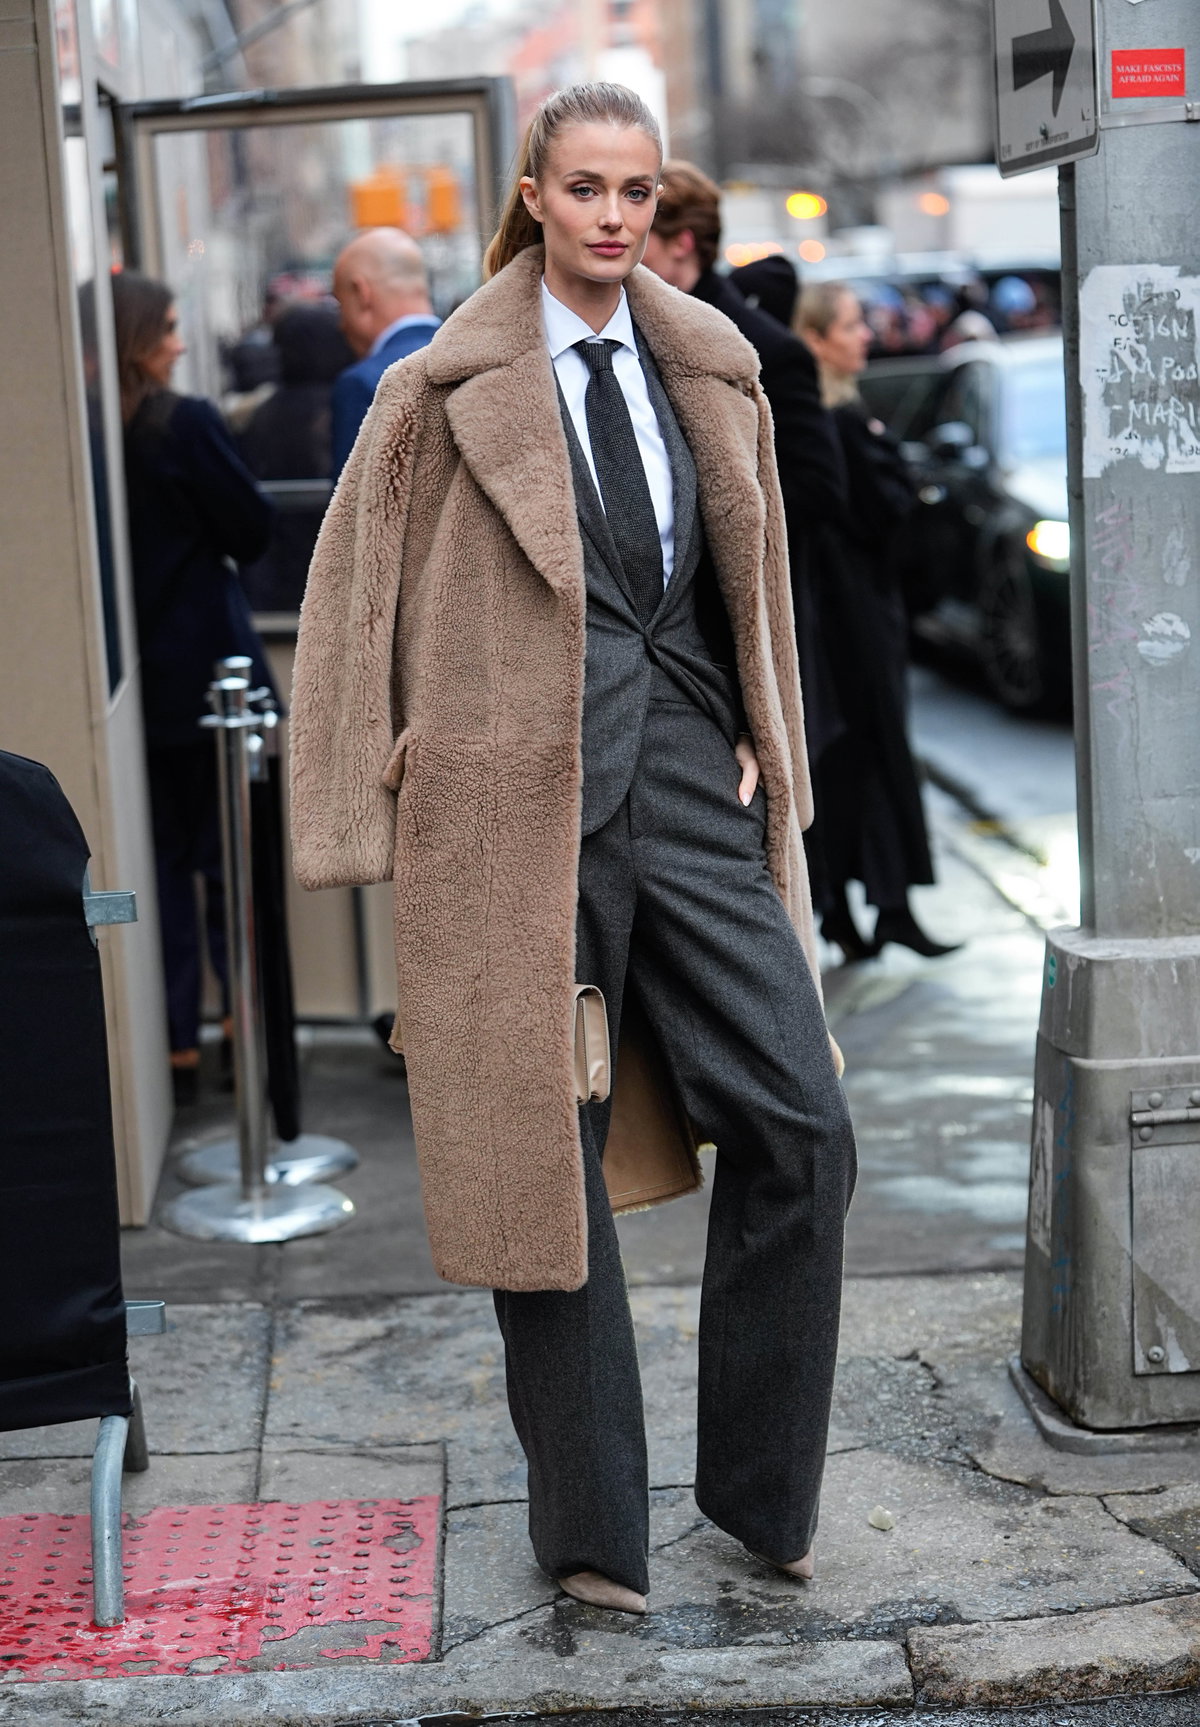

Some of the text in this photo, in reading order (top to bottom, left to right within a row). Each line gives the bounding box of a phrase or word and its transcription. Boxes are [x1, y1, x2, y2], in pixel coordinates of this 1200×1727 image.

[1116, 63, 1182, 73] MAKE FASCISTS
[1119, 74, 1180, 83] AFRAID AGAIN
